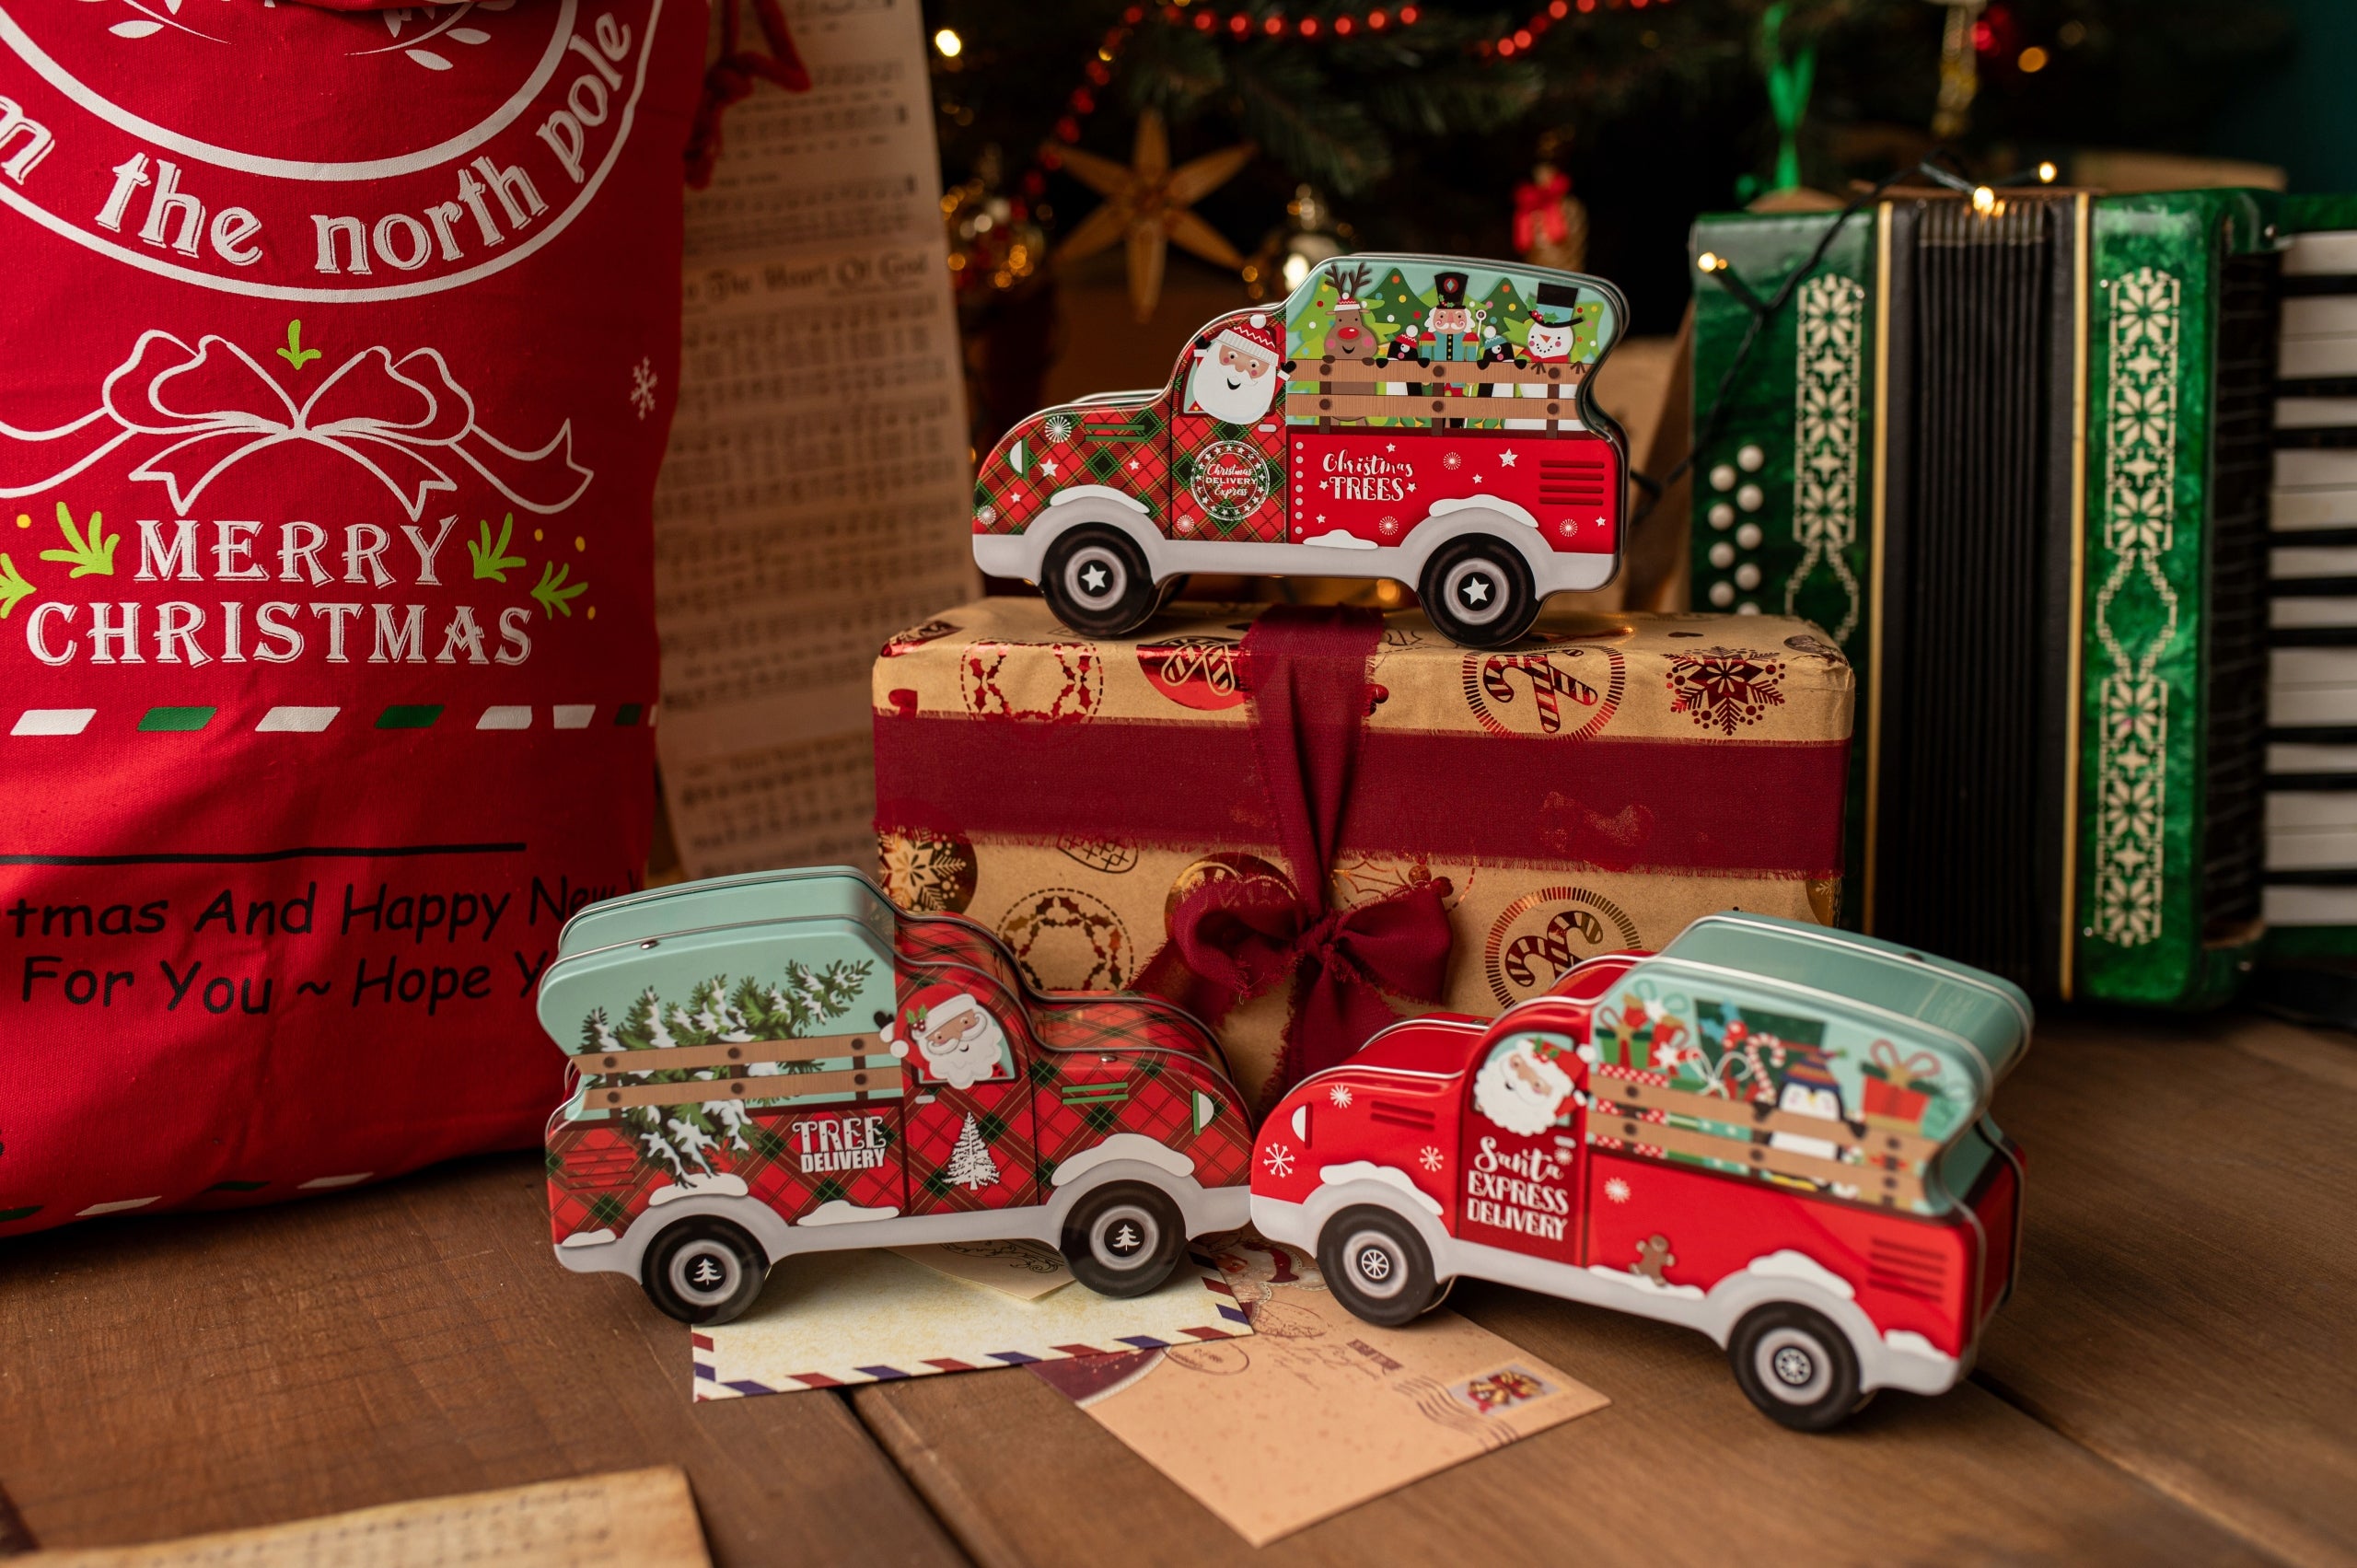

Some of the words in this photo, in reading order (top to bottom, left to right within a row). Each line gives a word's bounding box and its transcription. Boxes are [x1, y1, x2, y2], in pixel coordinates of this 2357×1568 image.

[95, 152, 264, 267] the
[309, 155, 550, 276] north
[536, 13, 632, 183] pole
[1206, 462, 1253, 477] Christmas
[1322, 448, 1414, 477] Christmas
[1214, 484, 1248, 498] Express
[1329, 476, 1405, 502] TREES
[134, 515, 458, 587] MERRY
[26, 601, 532, 668] CHRISTMAS
[6, 897, 169, 937] tmas
[194, 882, 318, 935] And
[341, 882, 512, 944] Happy
[528, 874, 616, 925] New
[21, 955, 134, 1006] For
[159, 960, 273, 1015] You
[352, 954, 492, 1015] Hope
[793, 1117, 887, 1153] TREE
[801, 1149, 886, 1173] DELIVERY
[1474, 1135, 1564, 1182] Santa
[1468, 1169, 1569, 1214] EXPRESS
[1468, 1198, 1567, 1241] DELIVERY
